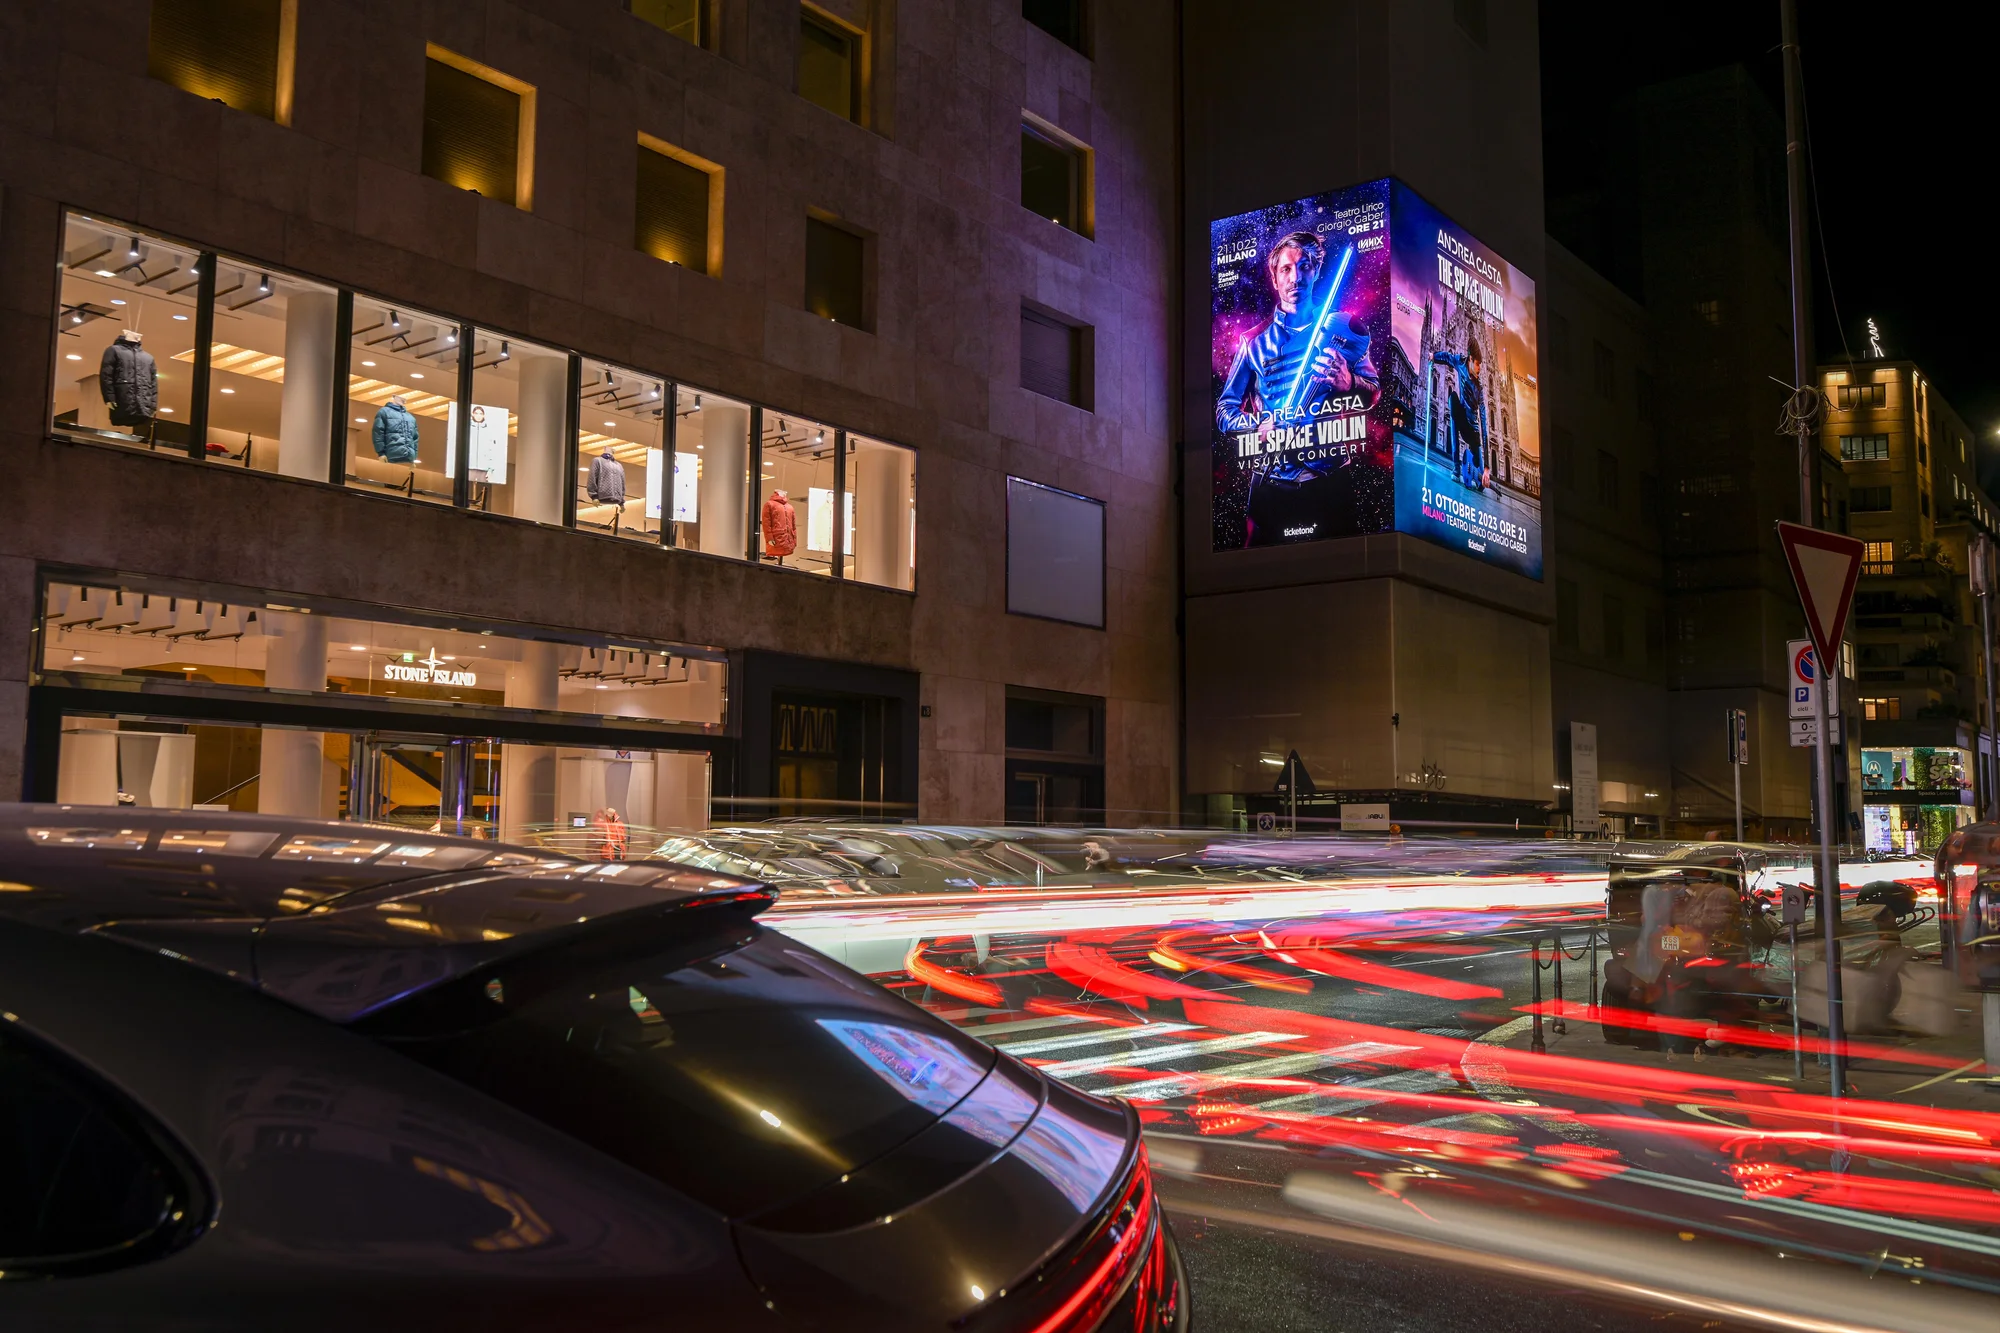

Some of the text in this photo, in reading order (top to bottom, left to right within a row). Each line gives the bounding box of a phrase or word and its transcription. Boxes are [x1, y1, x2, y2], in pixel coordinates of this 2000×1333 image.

[1317, 210, 1384, 234] Giorgio Gaber
[1333, 202, 1384, 220] Teatro Lirico
[1348, 219, 1384, 235] ORE 21
[1217, 249, 1256, 266] MILANO
[1437, 229, 1502, 288] ANDREA CASTA
[1437, 254, 1504, 322] THE SPACE VIOLIN
[1438, 284, 1504, 334] VISUAL CONCERT
[1236, 395, 1364, 428] ANDREA CASTA
[1236, 415, 1366, 458] THE SPACE VIOLIN
[1238, 443, 1366, 470] VISUAL CONCERT
[1422, 486, 1527, 544] 21 OTTOBRE 2023 ORE 21
[1284, 526, 1314, 536] ticketone
[1422, 504, 1528, 554] MILANO TEATRO LIRICO GIORGIO GABER
[384, 664, 476, 686] STONE ISLAND
[1798, 689, 1807, 700] P
